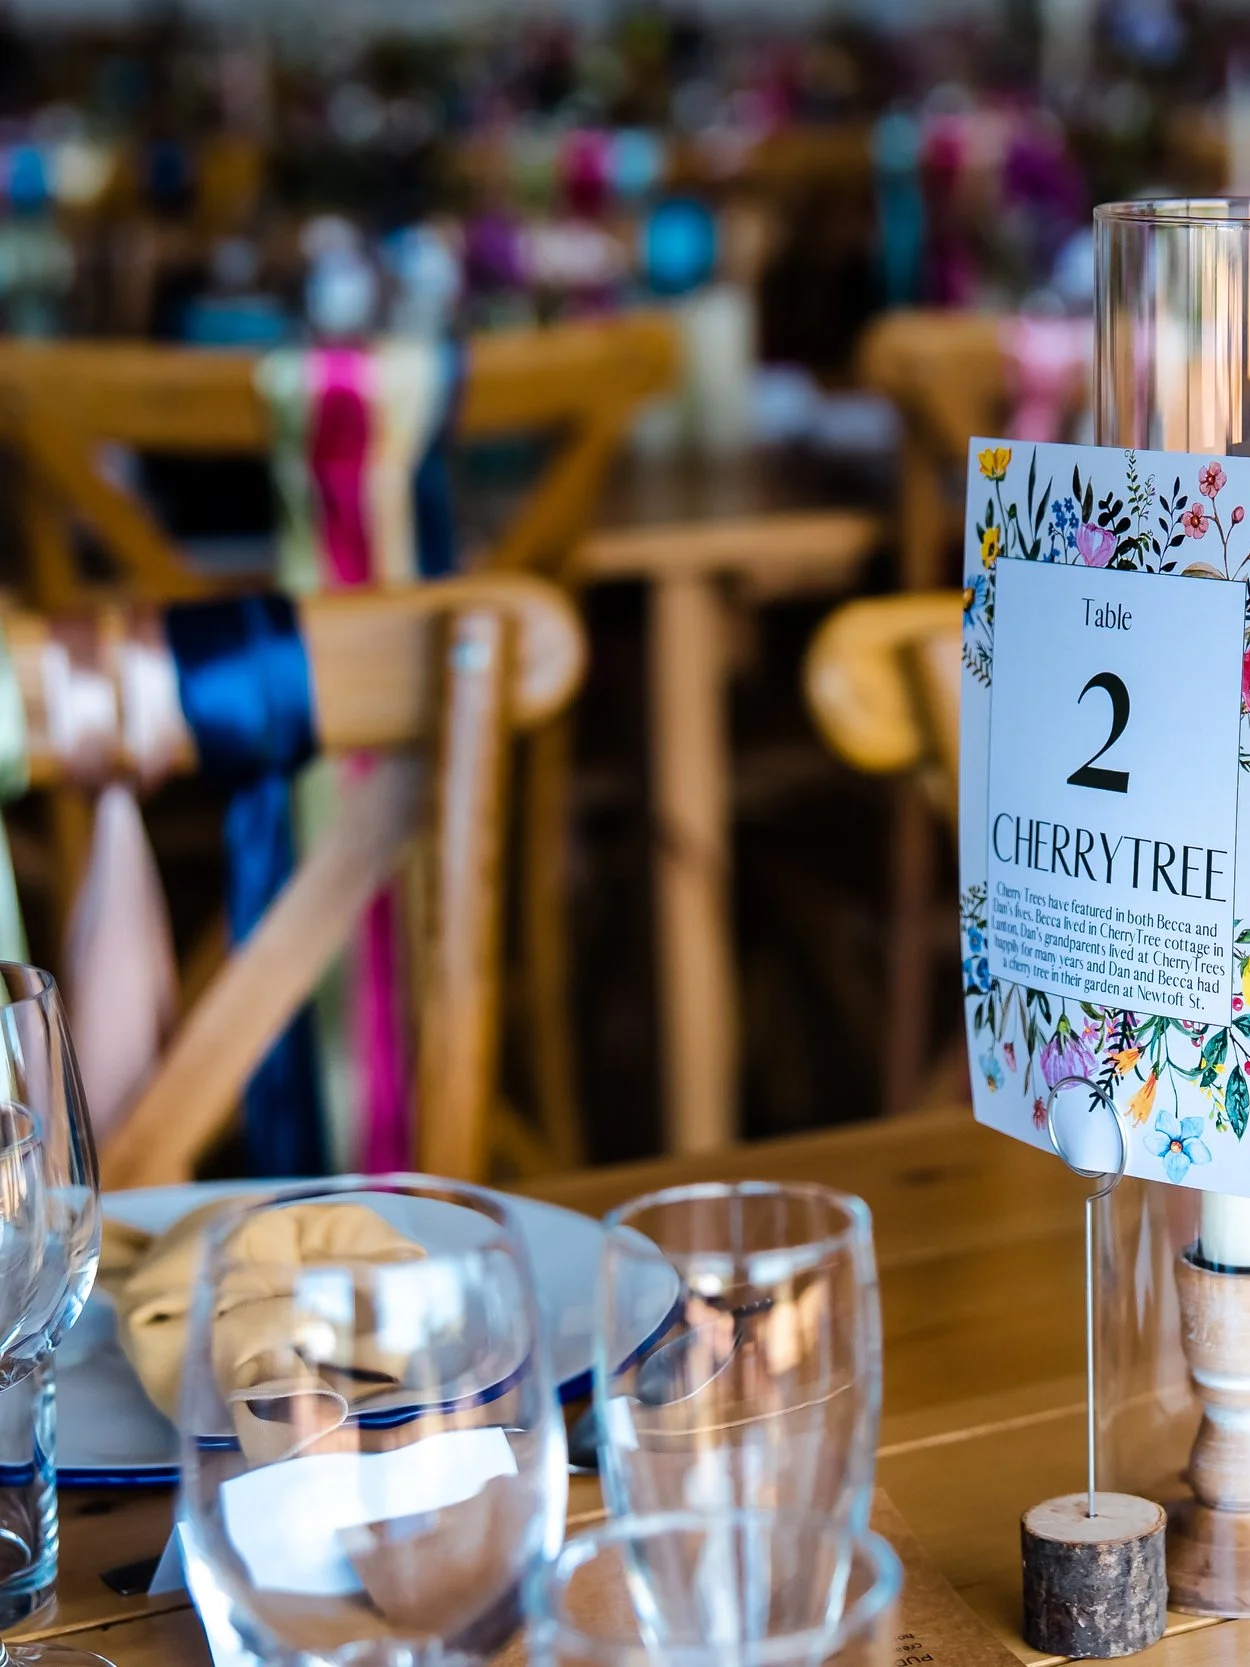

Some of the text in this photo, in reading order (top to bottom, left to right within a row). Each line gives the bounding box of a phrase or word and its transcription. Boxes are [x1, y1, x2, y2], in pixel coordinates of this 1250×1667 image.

[1082, 598, 1132, 631] Table
[1067, 671, 1130, 793] 2
[993, 812, 1228, 902] CHERRYTREE
[993, 897, 1013, 914] Dan's
[1036, 908, 1060, 928] Becca
[1064, 916, 1085, 933] lived
[1088, 921, 1097, 936] in
[1164, 938, 1210, 958] cottage
[1213, 943, 1224, 957] in
[996, 881, 1217, 938] Cherry Trees have featured in both Becca and
[1020, 922, 1042, 941] Dan's
[1044, 933, 1106, 956] grandparents
[1109, 943, 1134, 960] lived
[1137, 952, 1149, 963] at
[1021, 941, 1032, 957] for
[1034, 948, 1056, 967] many
[1059, 954, 1083, 969] years
[1087, 960, 1105, 974] and
[1109, 960, 1130, 978] Dan
[1133, 969, 1154, 982] and
[1158, 969, 1193, 990] Becca
[1197, 977, 1219, 994] had
[1003, 957, 1205, 1010] a cherry tree in their garden at Newtoft St.
